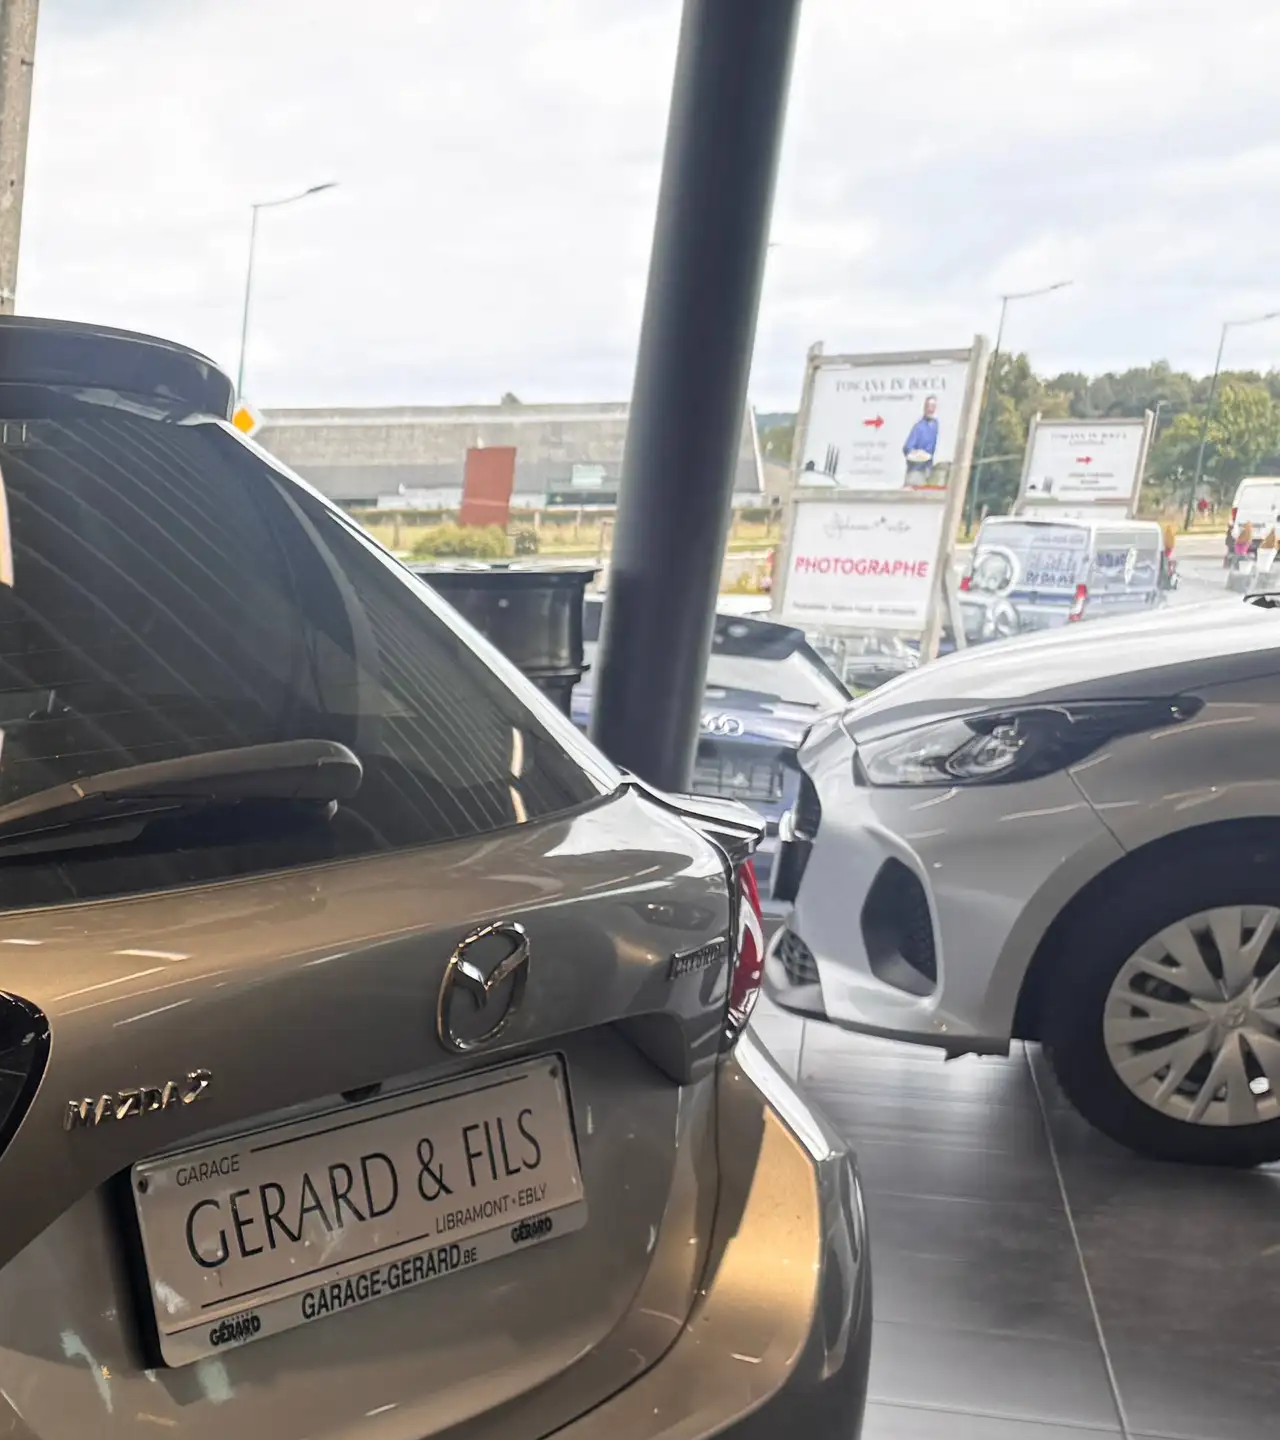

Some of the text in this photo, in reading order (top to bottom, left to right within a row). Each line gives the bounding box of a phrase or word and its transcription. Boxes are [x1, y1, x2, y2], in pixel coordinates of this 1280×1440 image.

[794, 556, 929, 578] PHOTOGRAPHE
[176, 1154, 241, 1187] GARAGE
[186, 1108, 541, 1269] GERARD & FILS
[435, 1183, 547, 1234] LIBRAMONT EBLY
